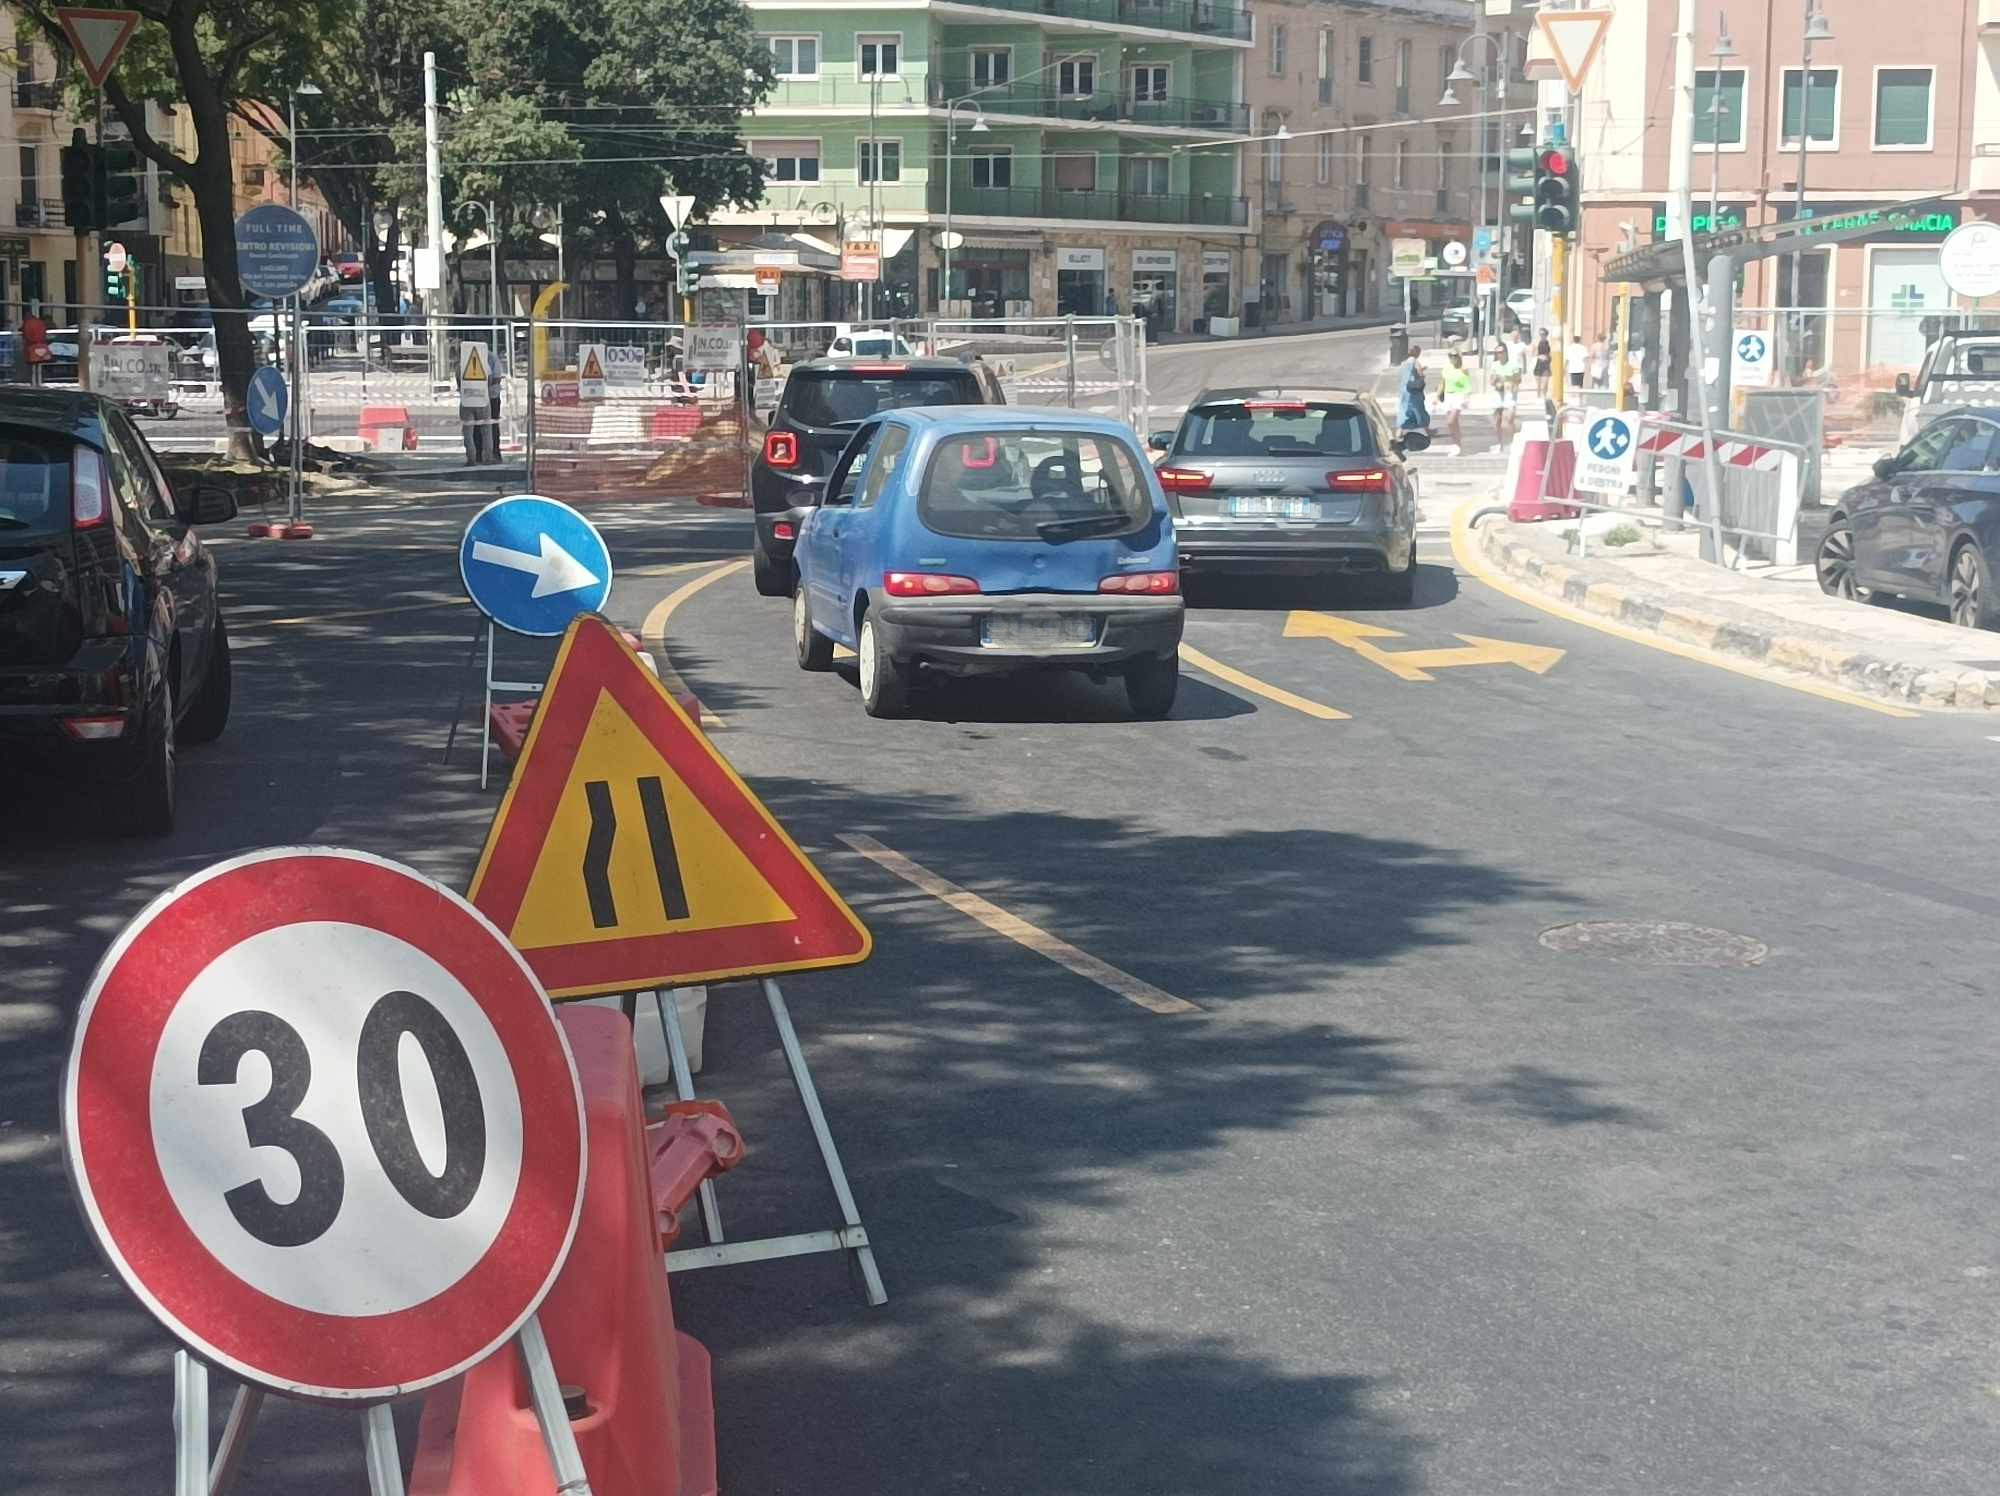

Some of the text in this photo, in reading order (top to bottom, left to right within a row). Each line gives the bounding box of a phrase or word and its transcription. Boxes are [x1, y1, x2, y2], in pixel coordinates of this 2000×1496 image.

[246, 223, 303, 233] FULL TIME
[237, 241, 268, 251] ENTRO
[845, 242, 877, 250] TAXI
[197, 990, 487, 1248] 30
